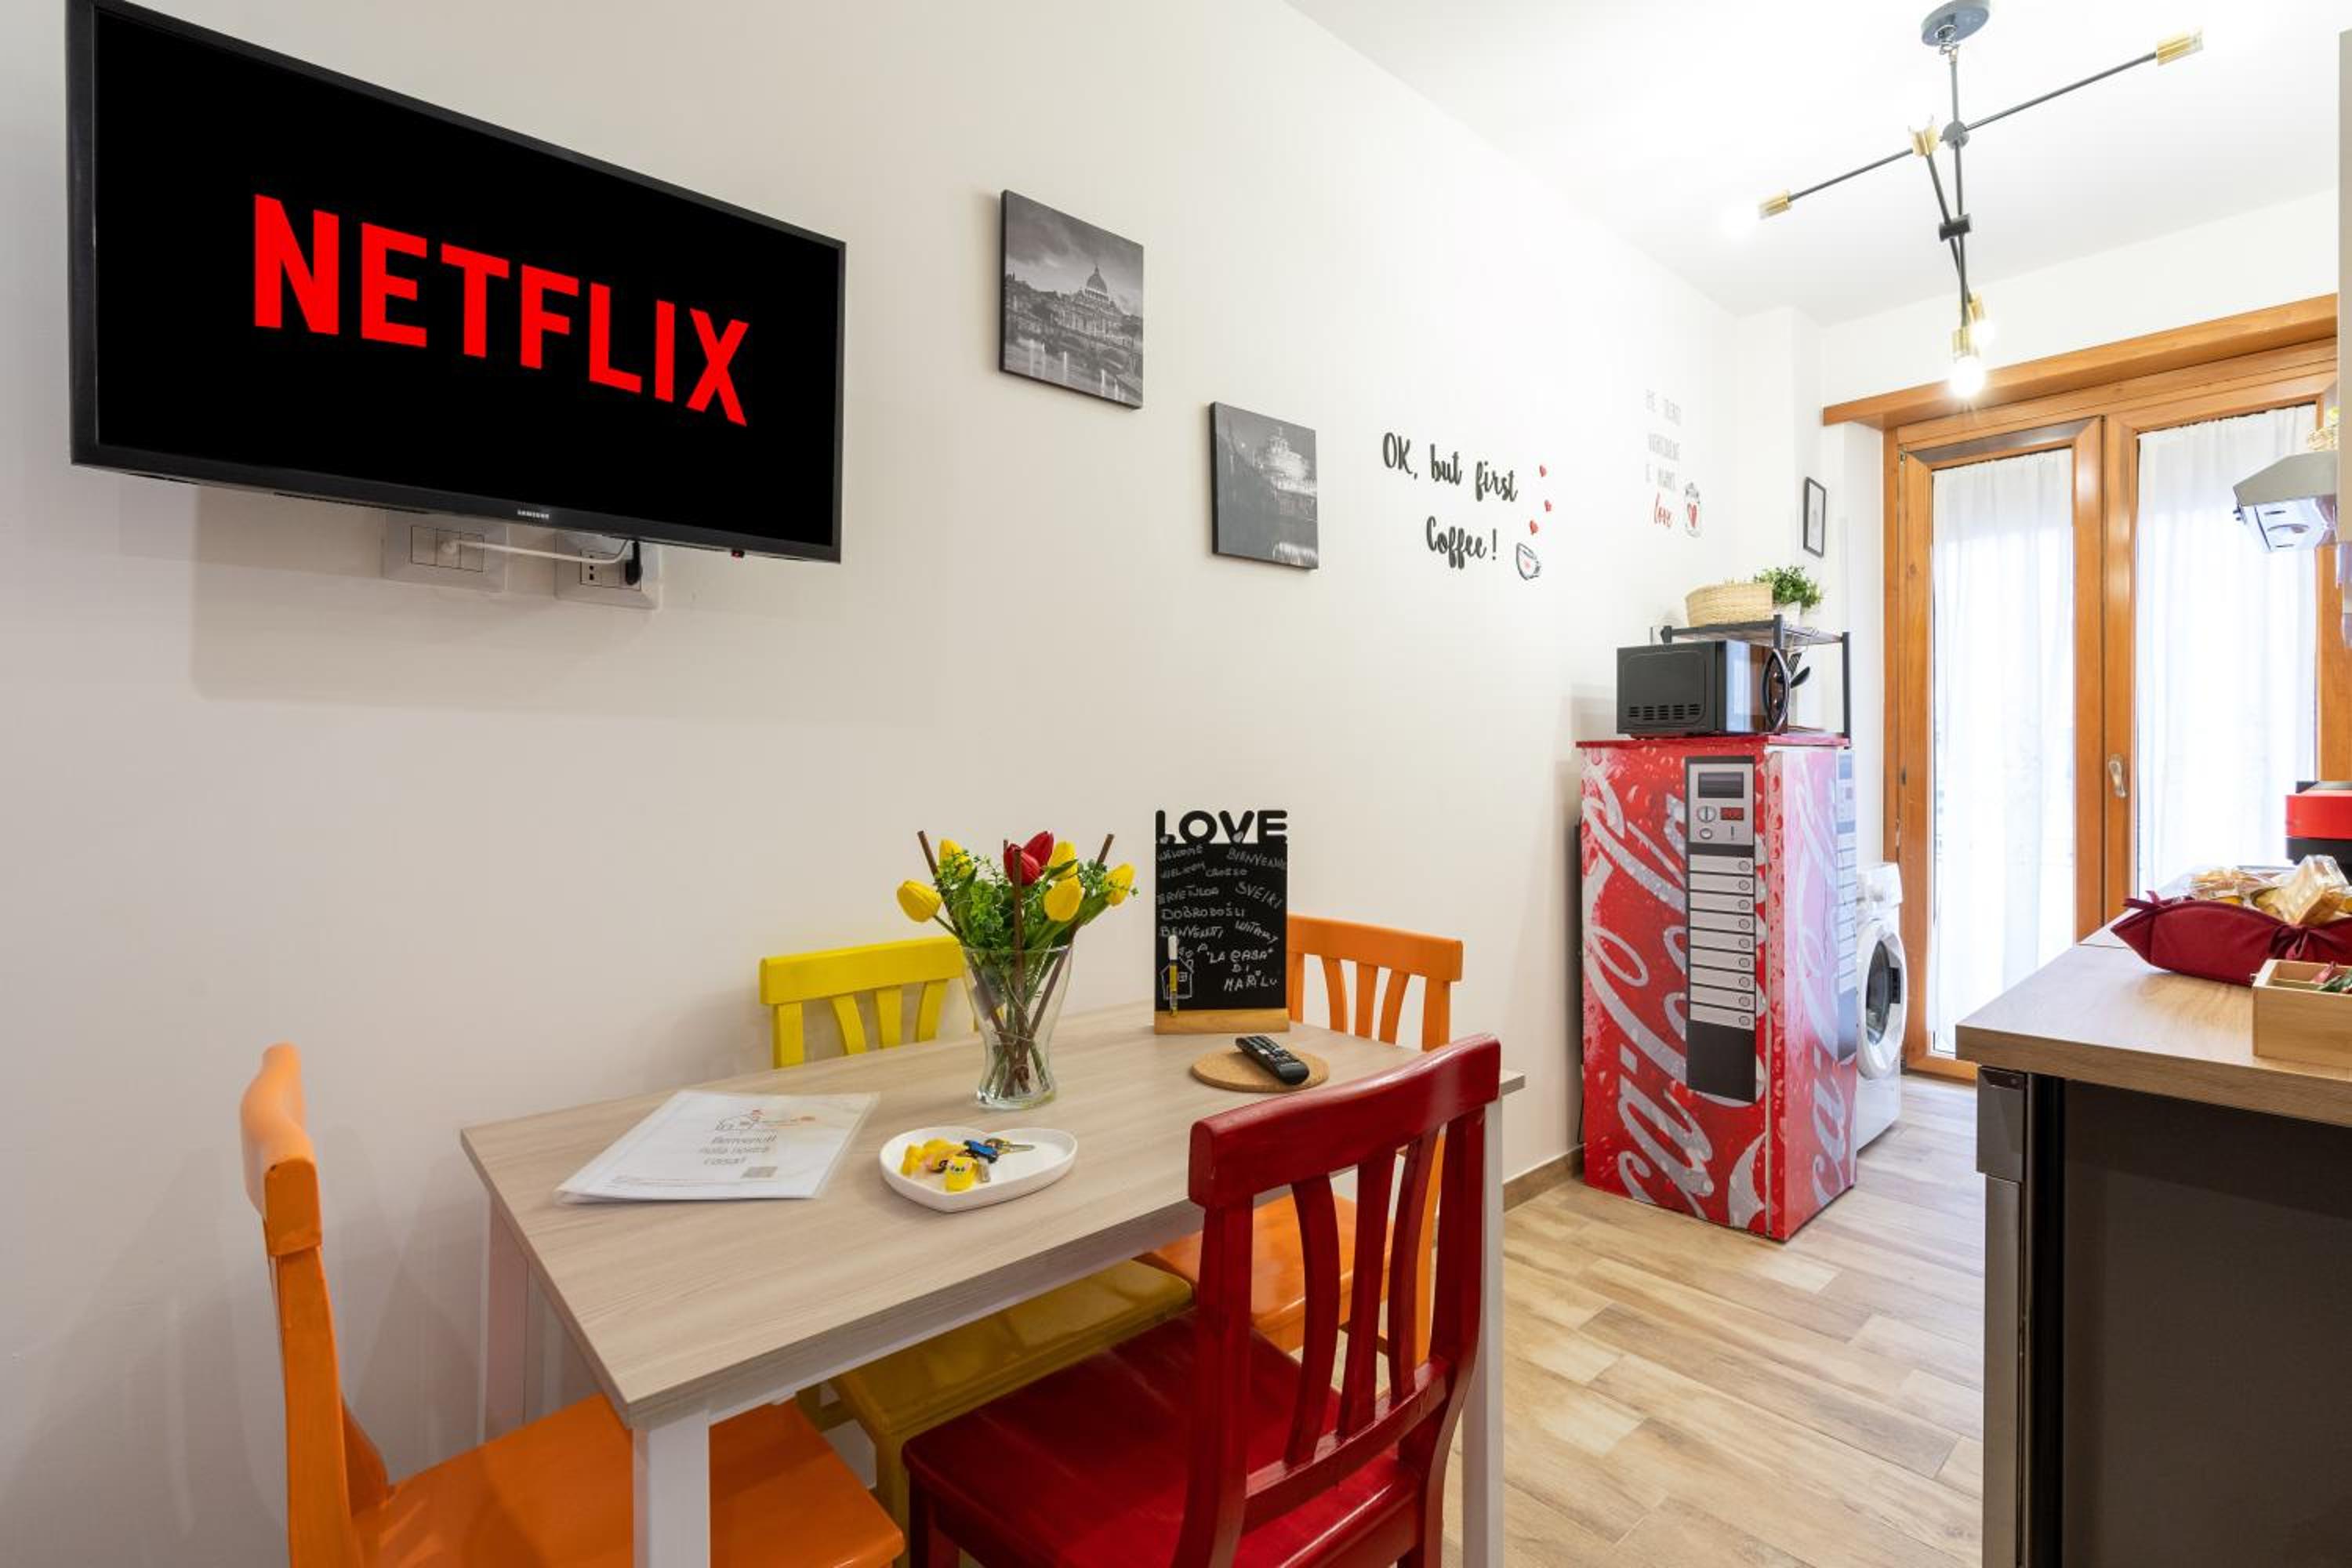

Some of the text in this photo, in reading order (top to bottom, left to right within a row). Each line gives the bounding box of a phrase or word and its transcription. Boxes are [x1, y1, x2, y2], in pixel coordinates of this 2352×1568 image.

[254, 194, 750, 427] NETFLIX
[1382, 432, 1519, 502] OK, but first
[1155, 809, 1288, 844] LOVE
